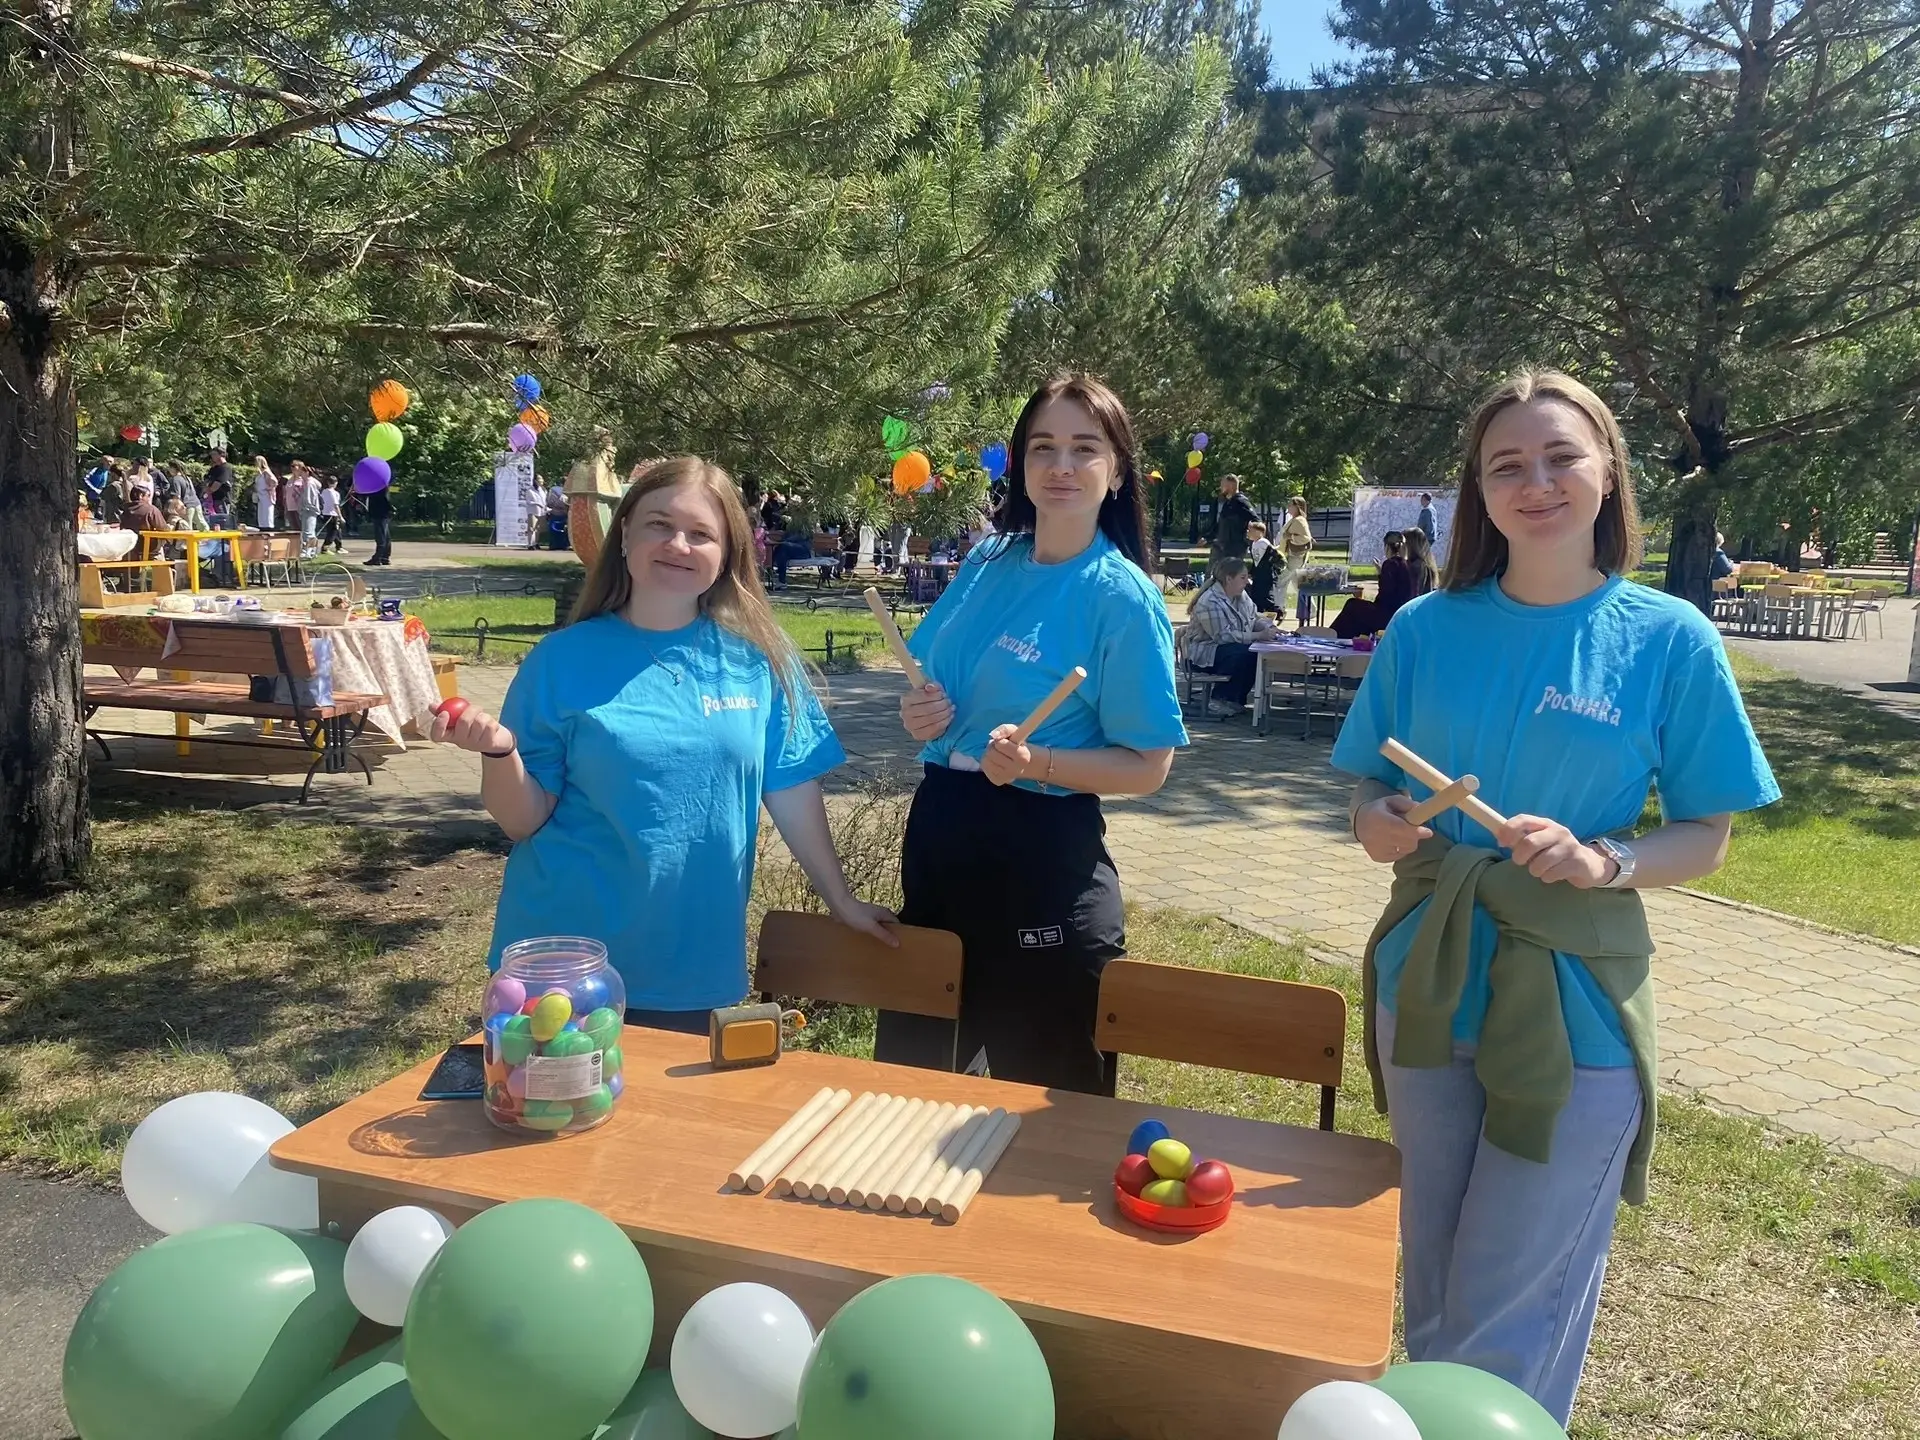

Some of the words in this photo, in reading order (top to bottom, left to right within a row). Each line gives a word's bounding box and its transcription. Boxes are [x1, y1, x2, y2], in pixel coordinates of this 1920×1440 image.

[991, 630, 1042, 663] осинка
[701, 693, 759, 717] Росинка
[1534, 685, 1622, 727] Росинка
